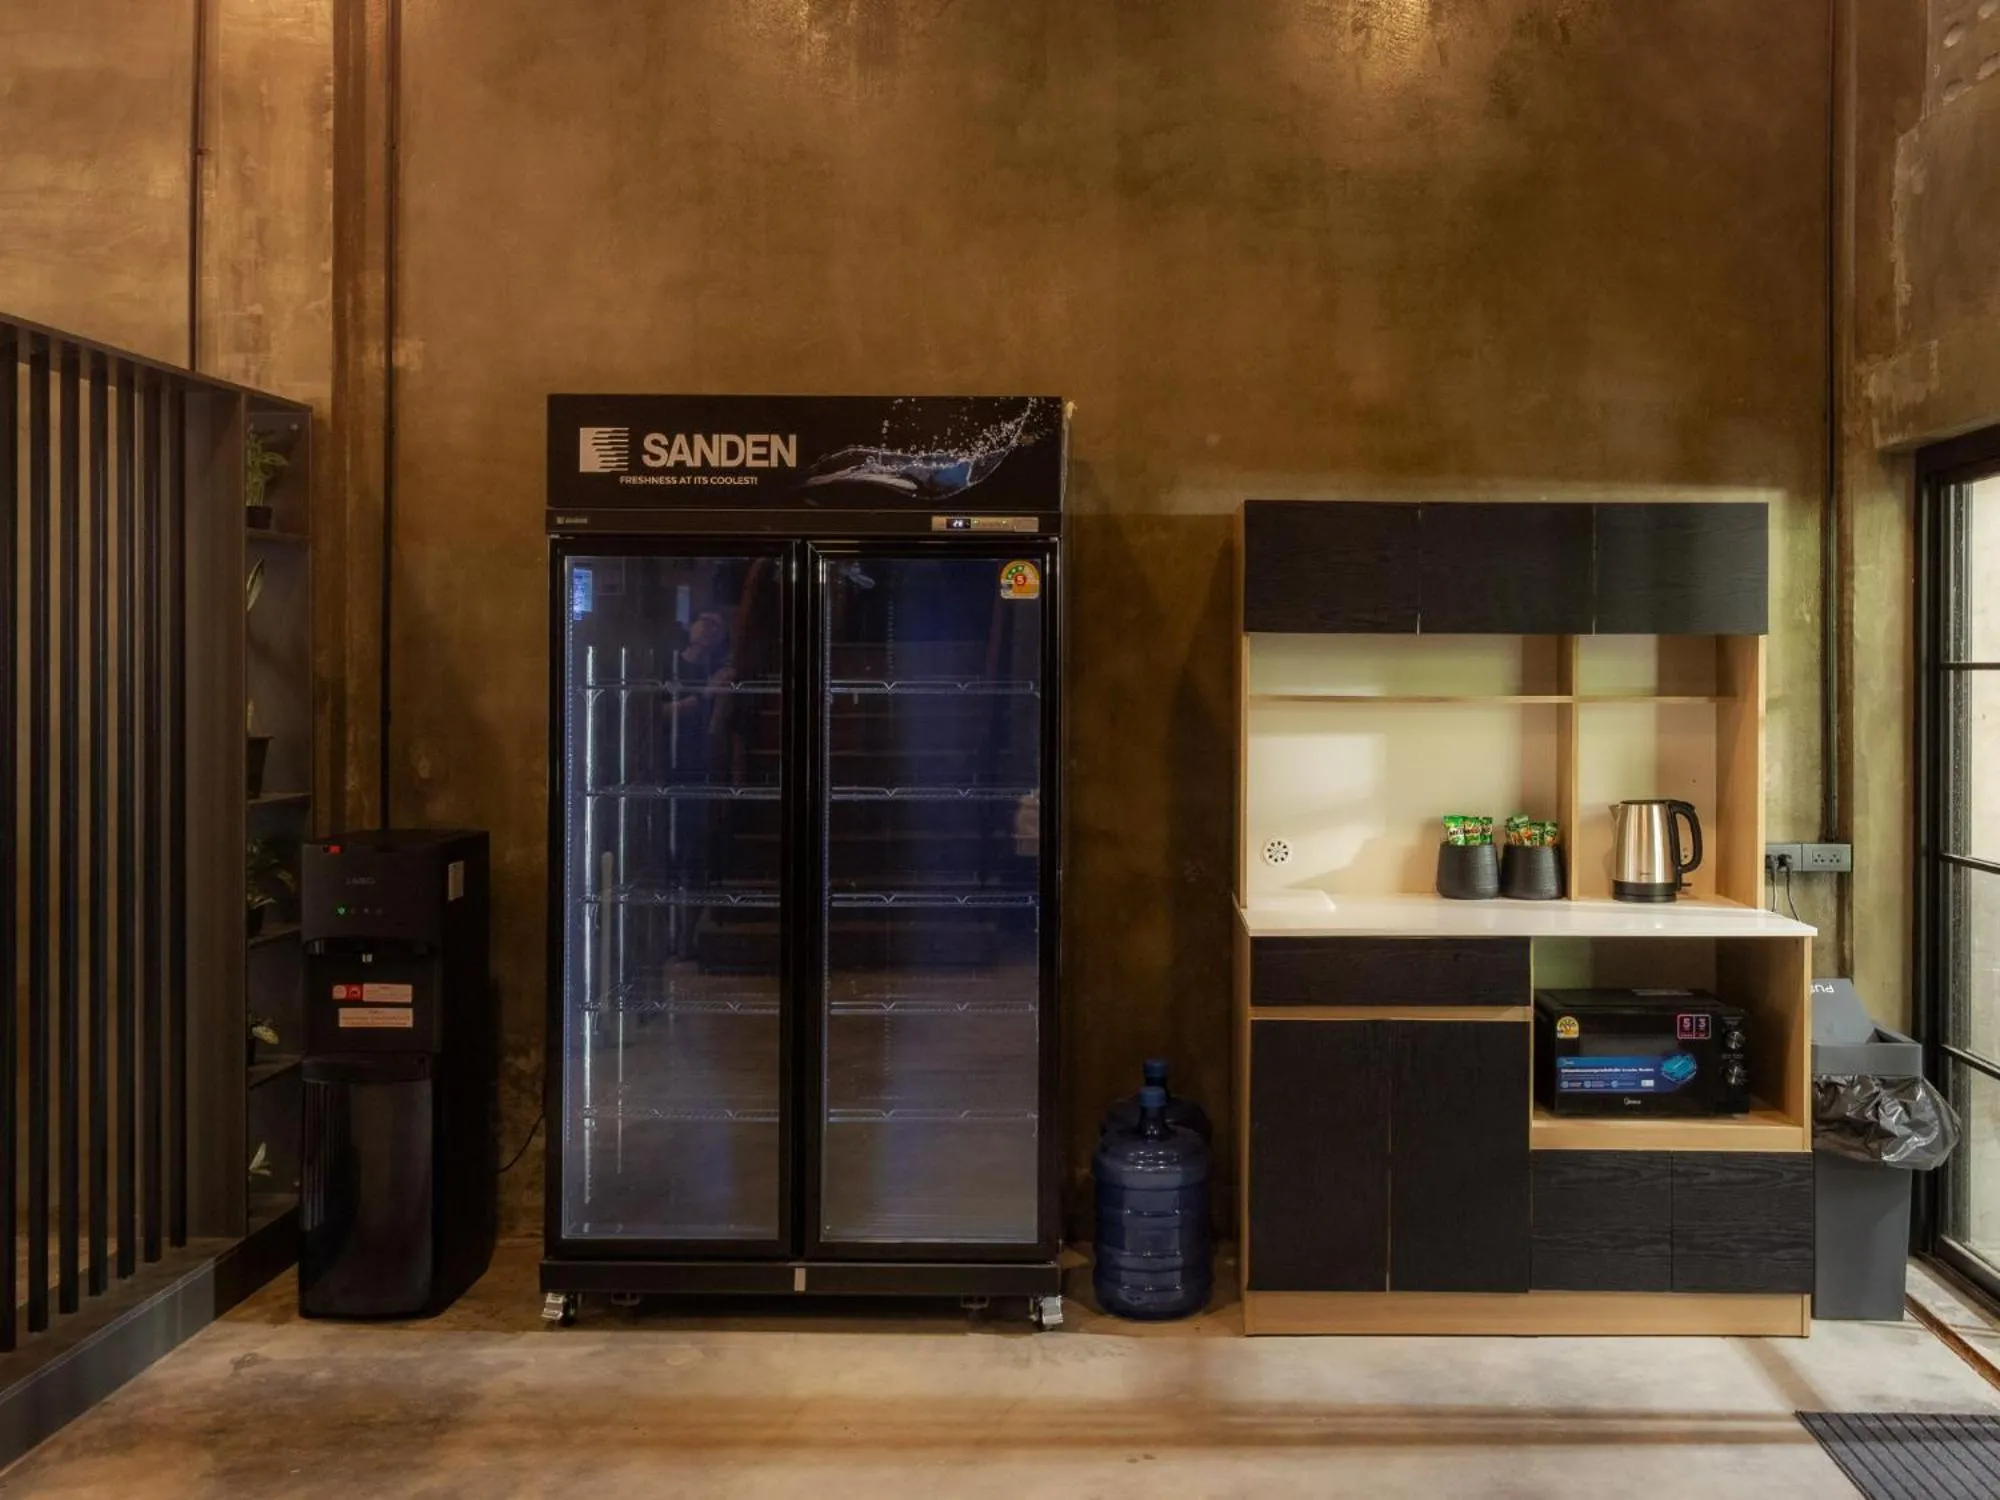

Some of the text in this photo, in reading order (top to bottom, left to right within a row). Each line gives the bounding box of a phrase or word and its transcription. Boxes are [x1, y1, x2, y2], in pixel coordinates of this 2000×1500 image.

[642, 432, 797, 468] SANDEN
[619, 475, 758, 485] FRESHNESS AT ITS COOLEST!
[1016, 575, 1025, 585] 5
